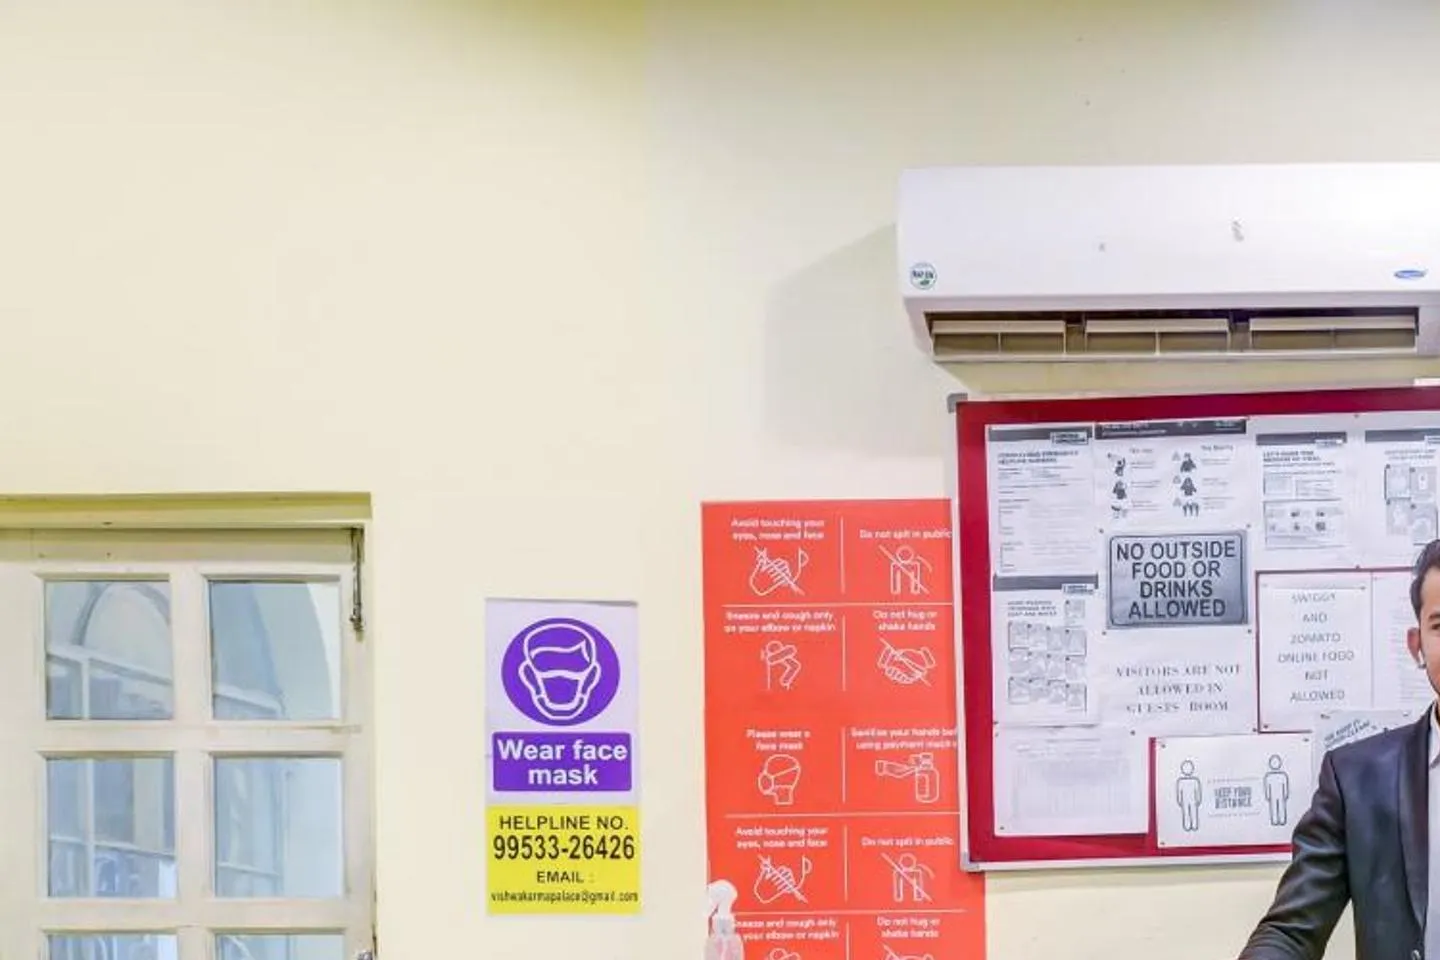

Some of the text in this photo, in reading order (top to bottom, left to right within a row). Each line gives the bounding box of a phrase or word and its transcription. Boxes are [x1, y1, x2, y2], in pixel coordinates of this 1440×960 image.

[1116, 540, 1237, 561] NO OUTSIDE
[1132, 560, 1222, 580] FOOD OR
[1139, 579, 1214, 599] DRINKS
[1128, 598, 1227, 619] ALLOWED
[1302, 612, 1328, 623] AND
[1290, 632, 1341, 645] ZOMATO
[1278, 651, 1318, 664] ONLINE
[1116, 663, 1241, 678] VISITORS ARE NOT
[1305, 669, 1328, 681] NOT
[1139, 682, 1223, 696] ALLOWED IN
[1290, 690, 1346, 702] ALLOWED
[1189, 700, 1229, 712] ROOM
[497, 738, 628, 762] Wear face
[528, 763, 600, 786] mask
[499, 815, 629, 831] HELPLINE NO.
[493, 834, 636, 861] 99533-26426
[536, 870, 585, 884] EMAIL
[490, 889, 639, 905] vishwakarmapalace@gmail.com
[735, 920, 765, 928] neeze
